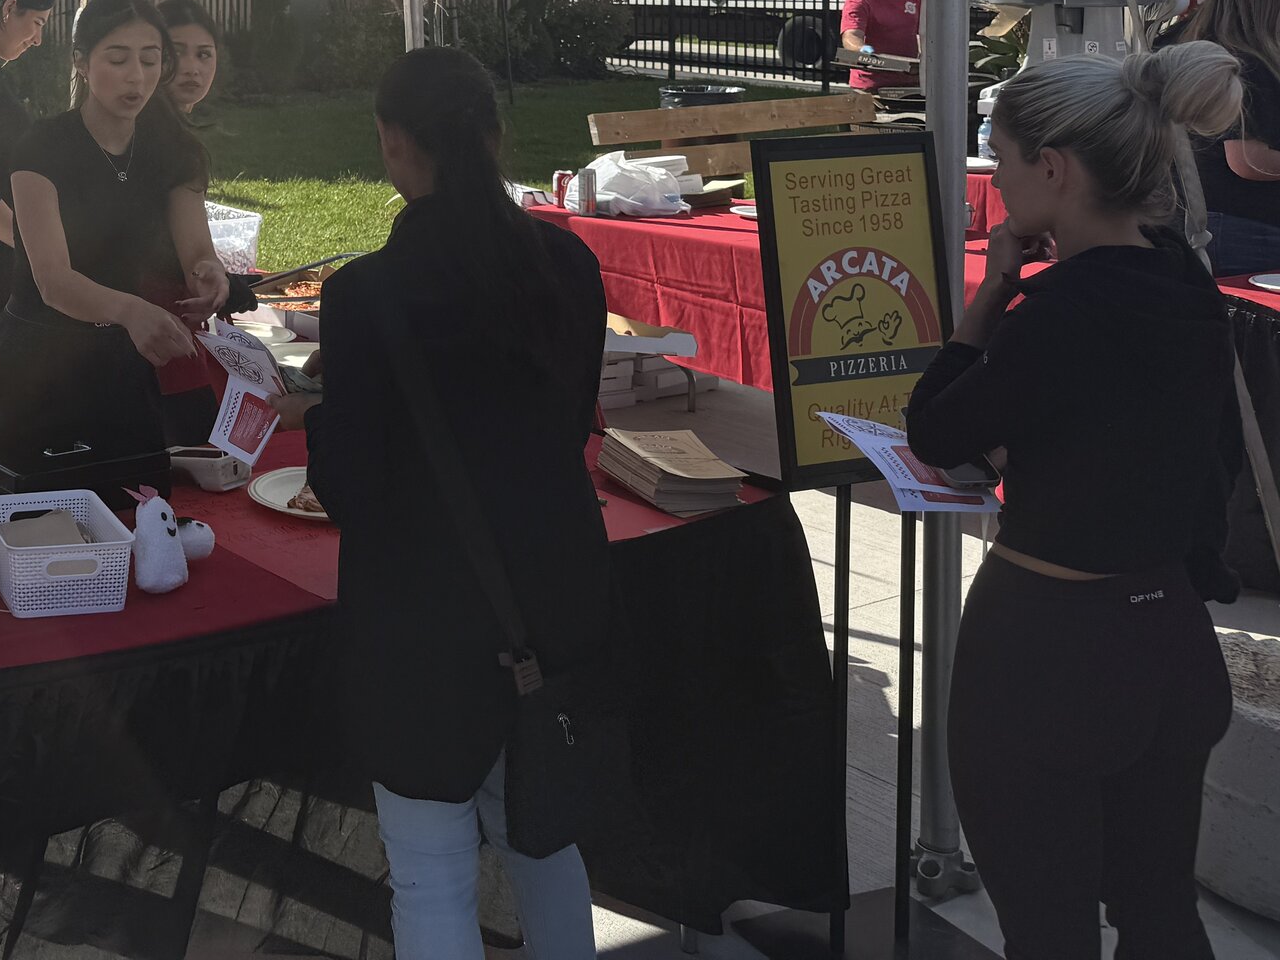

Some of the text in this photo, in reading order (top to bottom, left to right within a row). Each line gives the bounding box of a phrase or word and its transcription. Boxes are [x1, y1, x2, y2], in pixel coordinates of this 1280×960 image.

[858, 55, 885, 66] ENJOY!
[785, 165, 913, 191] Serving Great
[790, 189, 912, 215] Tasting Pizza
[802, 211, 904, 238] Since 1958
[806, 250, 910, 304] ARCATA
[829, 355, 908, 377] PIZZERIA
[807, 399, 874, 422] Quality
[878, 394, 898, 414] At
[821, 428, 852, 450] Rig
